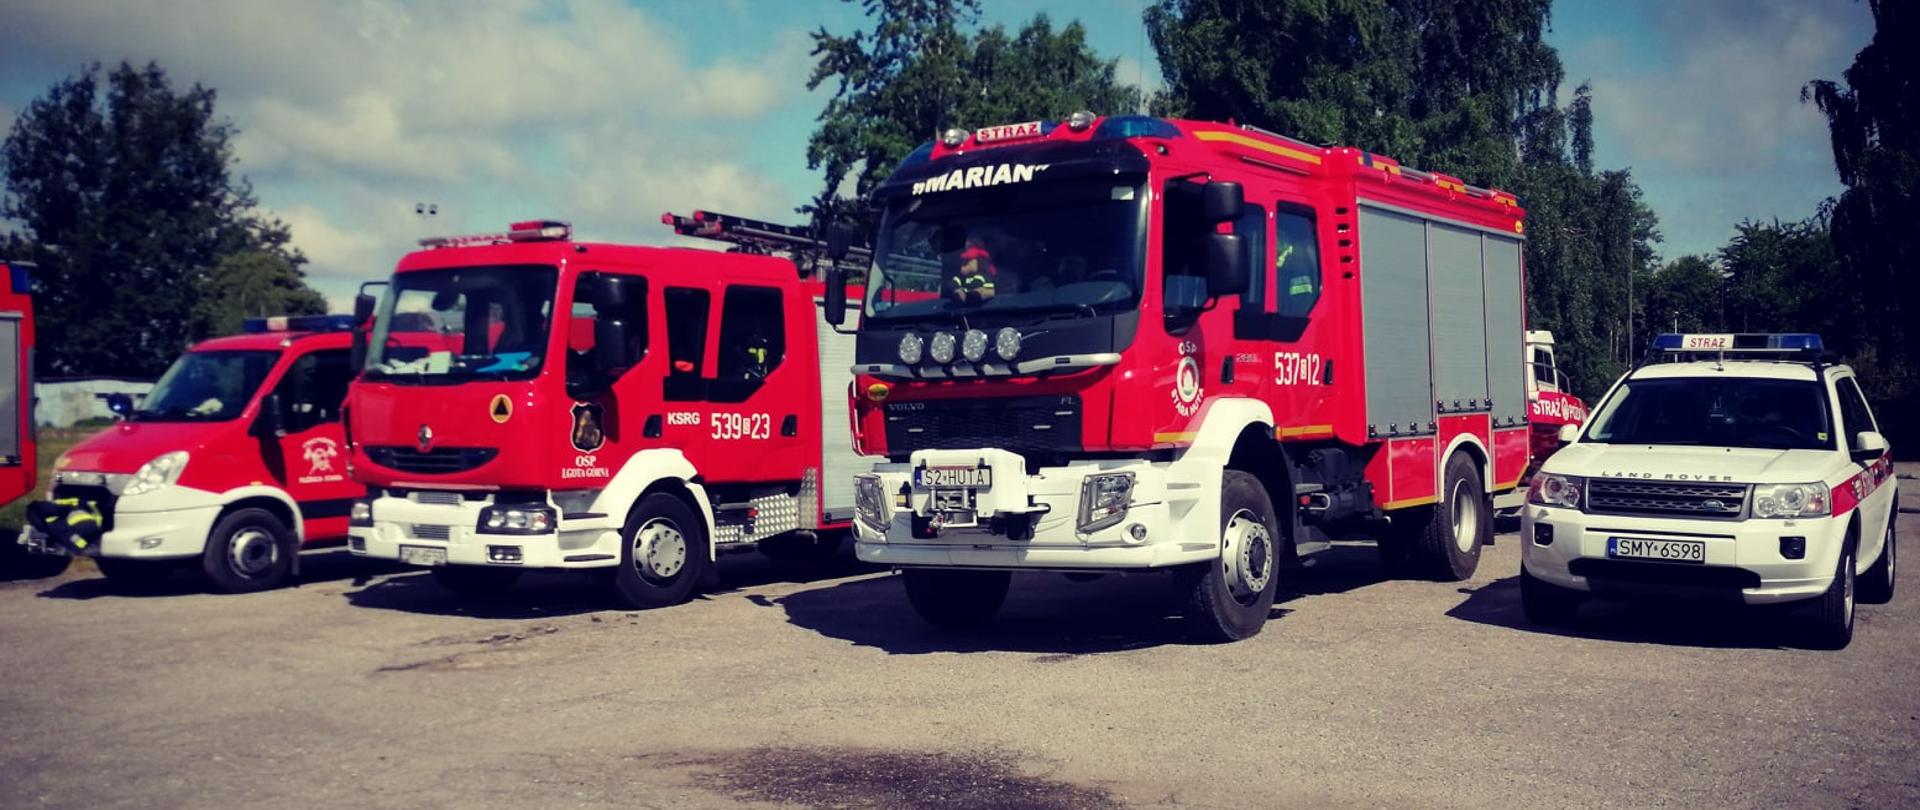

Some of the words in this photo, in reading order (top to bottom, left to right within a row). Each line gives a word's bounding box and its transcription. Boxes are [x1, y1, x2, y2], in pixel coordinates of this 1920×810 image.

[888, 402, 925, 411] VOLVO
[1533, 398, 1561, 417] STRAŻ
[667, 412, 701, 425] KSRG
[575, 455, 597, 468] OSP
[1601, 471, 1652, 479] LAND
[1664, 473, 1732, 481] ROVER
[1619, 539, 1654, 556] SMY
[1660, 542, 1701, 559] 6S98
